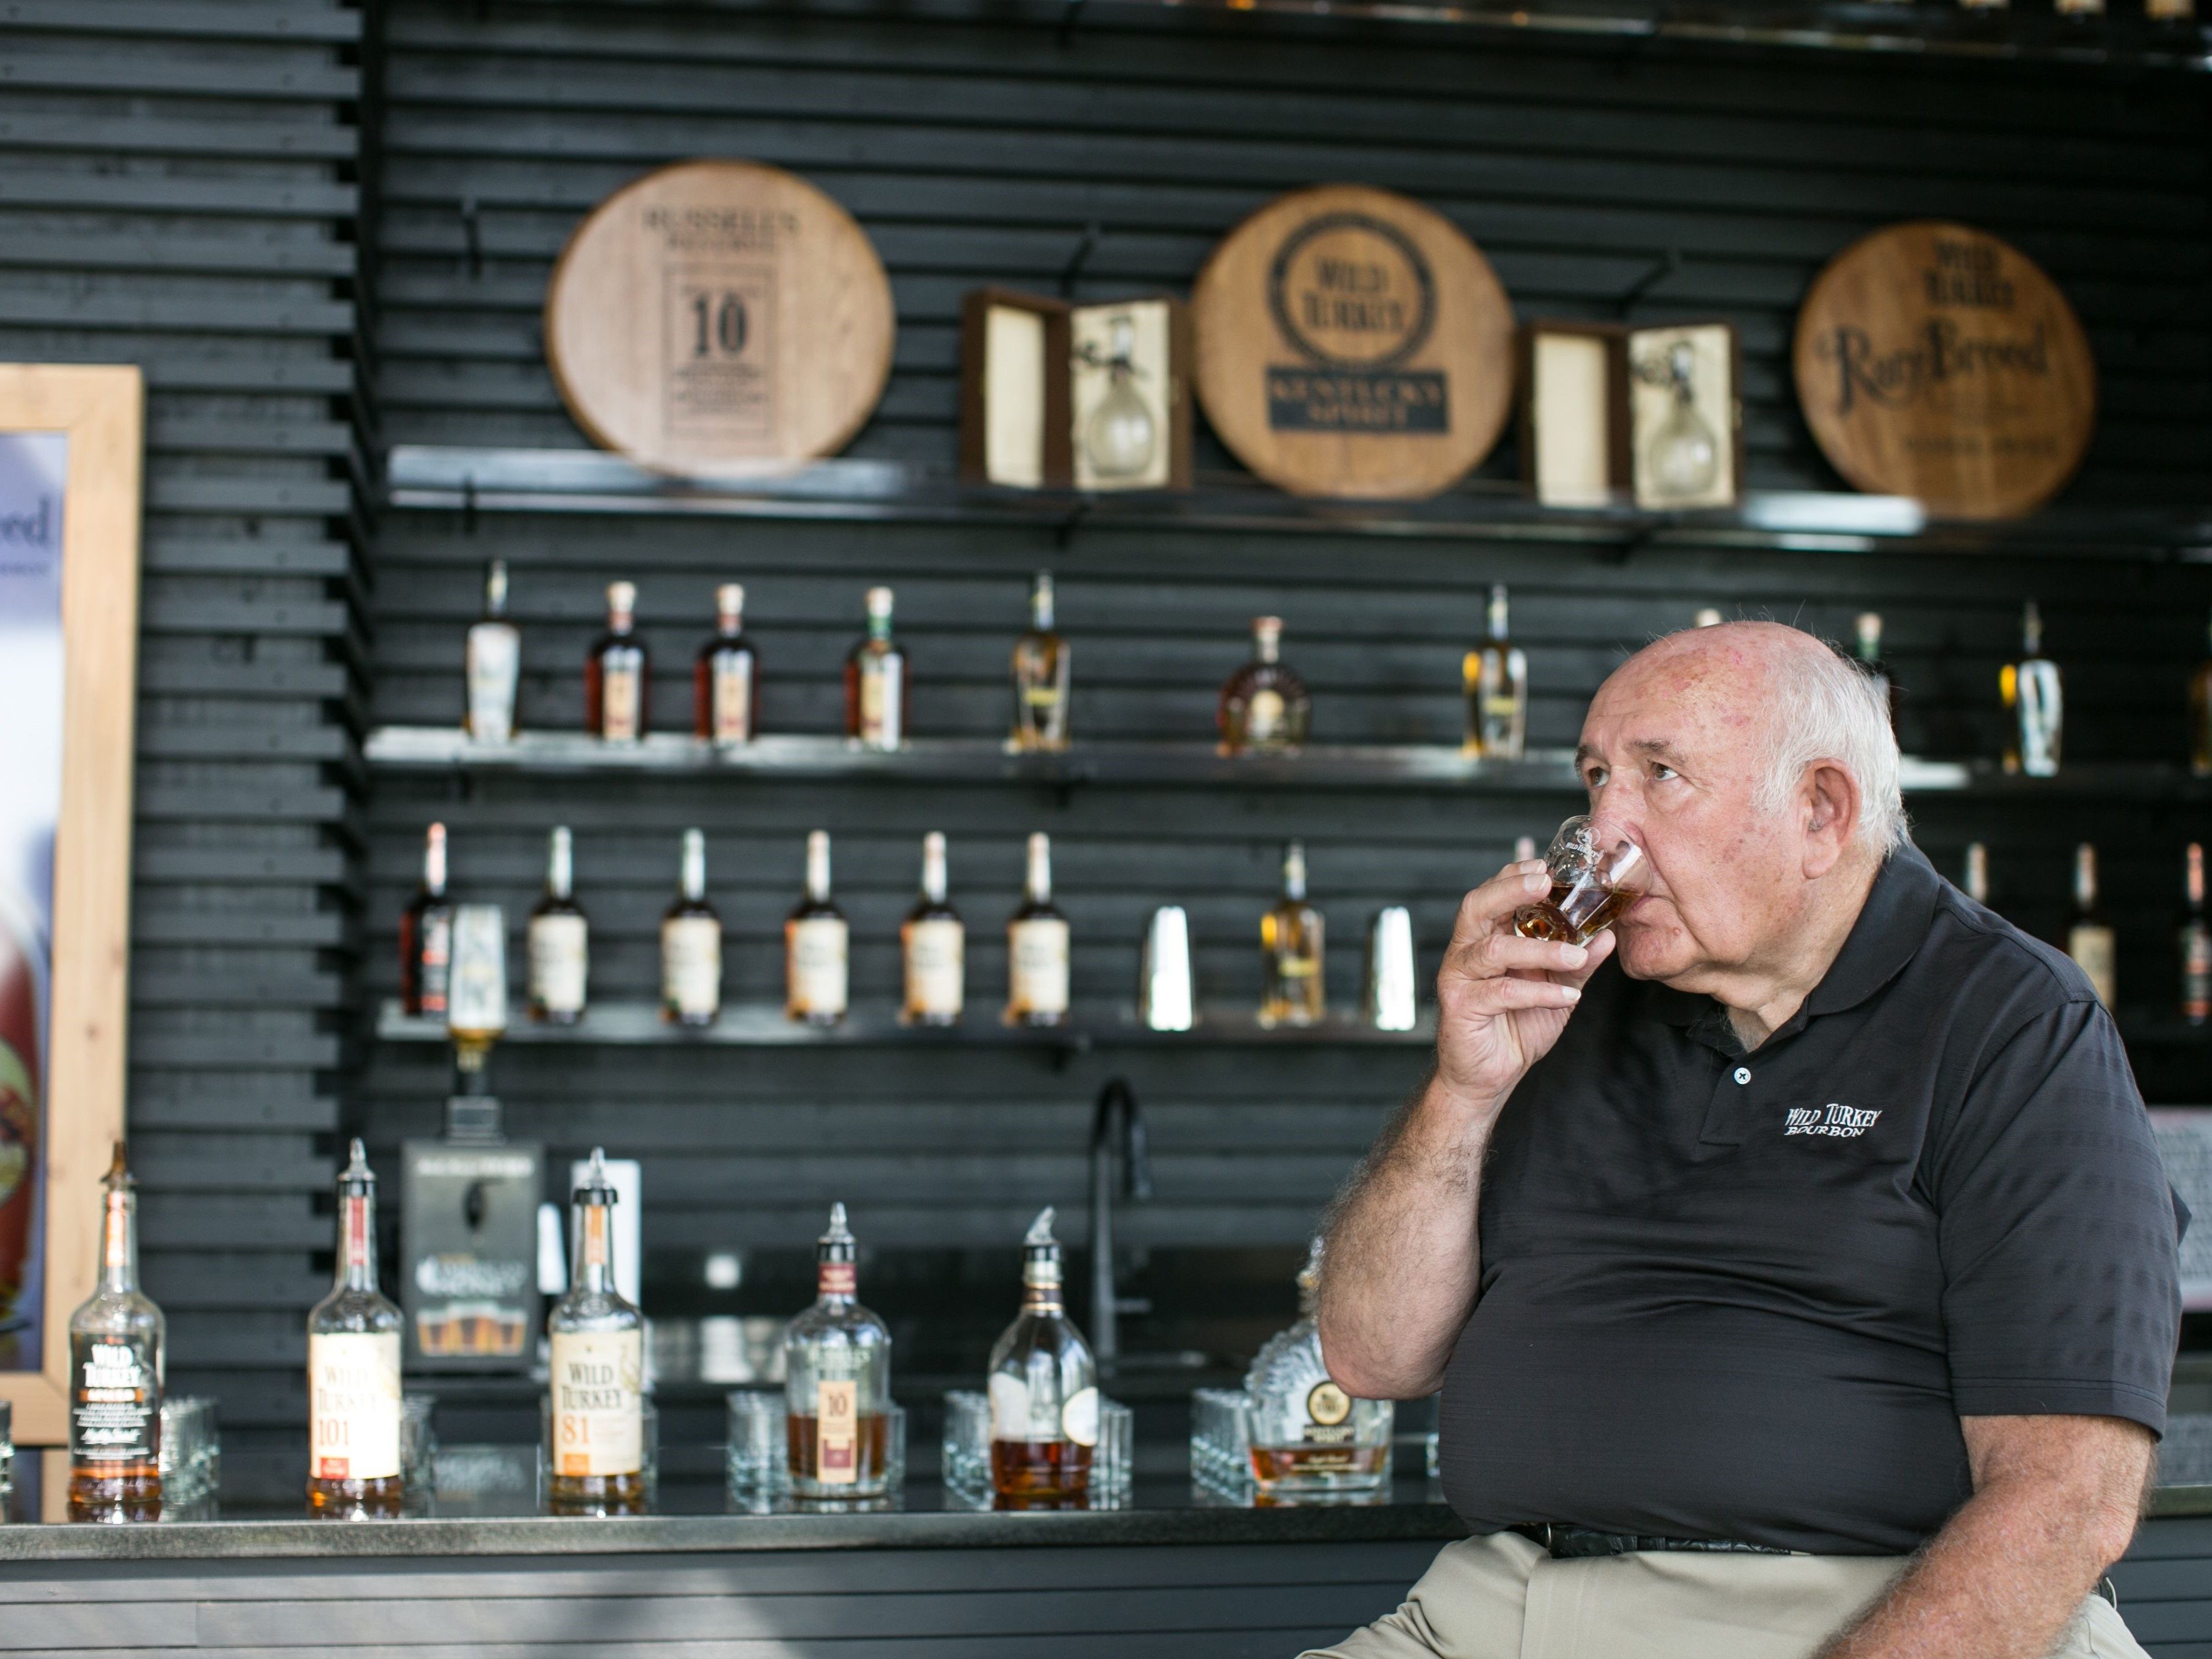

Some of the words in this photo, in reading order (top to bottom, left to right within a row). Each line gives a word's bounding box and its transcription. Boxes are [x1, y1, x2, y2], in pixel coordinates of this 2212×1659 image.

[1317, 258, 1389, 293] WILD
[694, 289, 749, 360] 10
[1303, 291, 1405, 333] TURKEY
[1785, 1108, 1822, 1126] WILD
[1824, 1103, 1882, 1127] TURKEY
[1784, 1125, 1864, 1137] BOURBON
[91, 1344, 133, 1369] WILD
[568, 1362, 614, 1384] WILD
[561, 1384, 624, 1410] TURKEY
[828, 1393, 848, 1418] 10
[318, 1419, 349, 1447] 101
[562, 1415, 590, 1444] 81
